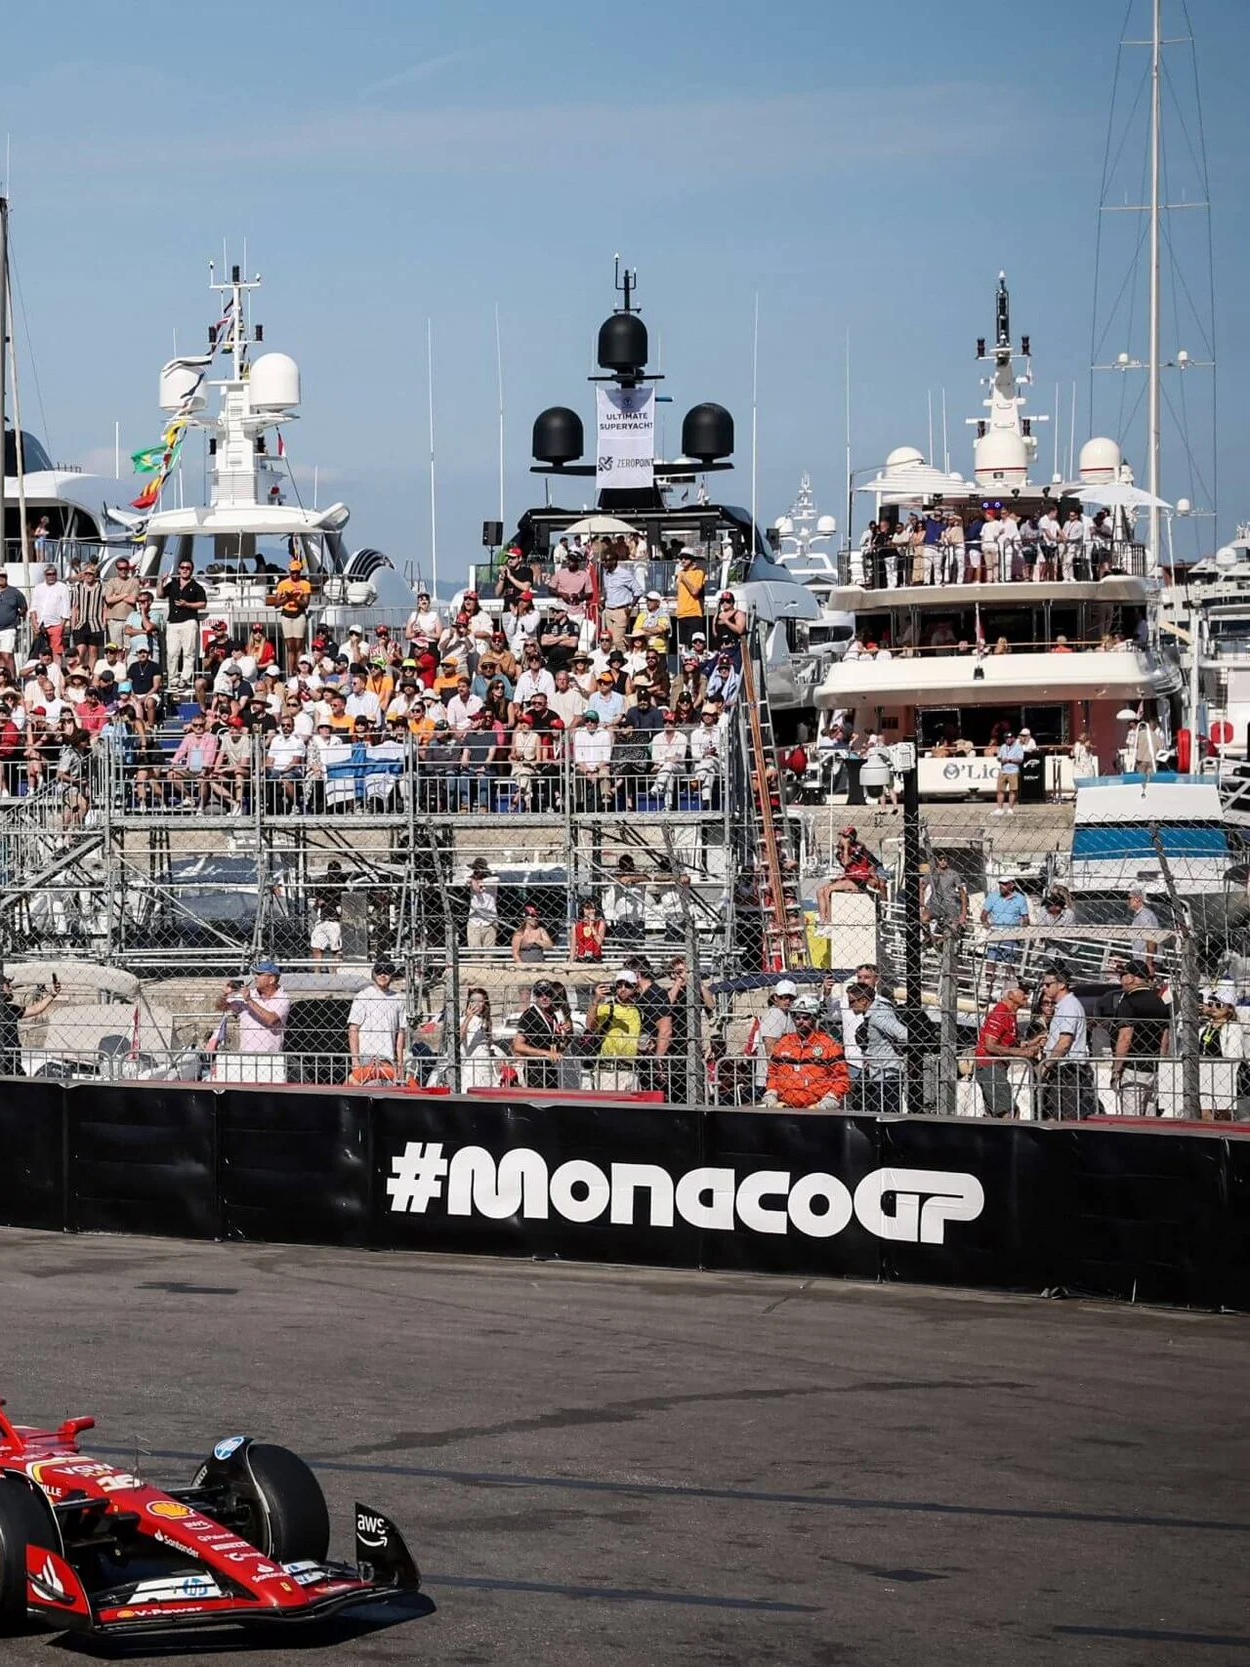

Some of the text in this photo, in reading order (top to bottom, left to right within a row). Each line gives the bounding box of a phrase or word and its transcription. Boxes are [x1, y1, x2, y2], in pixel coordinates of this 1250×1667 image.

[606, 412, 648, 420] ULTIMATE
[599, 422, 653, 430] SUPERYACHT
[617, 458, 655, 468] ZEROPOINT
[386, 1141, 985, 1244] #MonacoGP
[53, 1463, 115, 1475] VGW
[96, 1474, 144, 1492] 16
[357, 1513, 386, 1535] aws
[163, 1534, 200, 1559] Santander
[134, 1606, 203, 1617] V-Power
